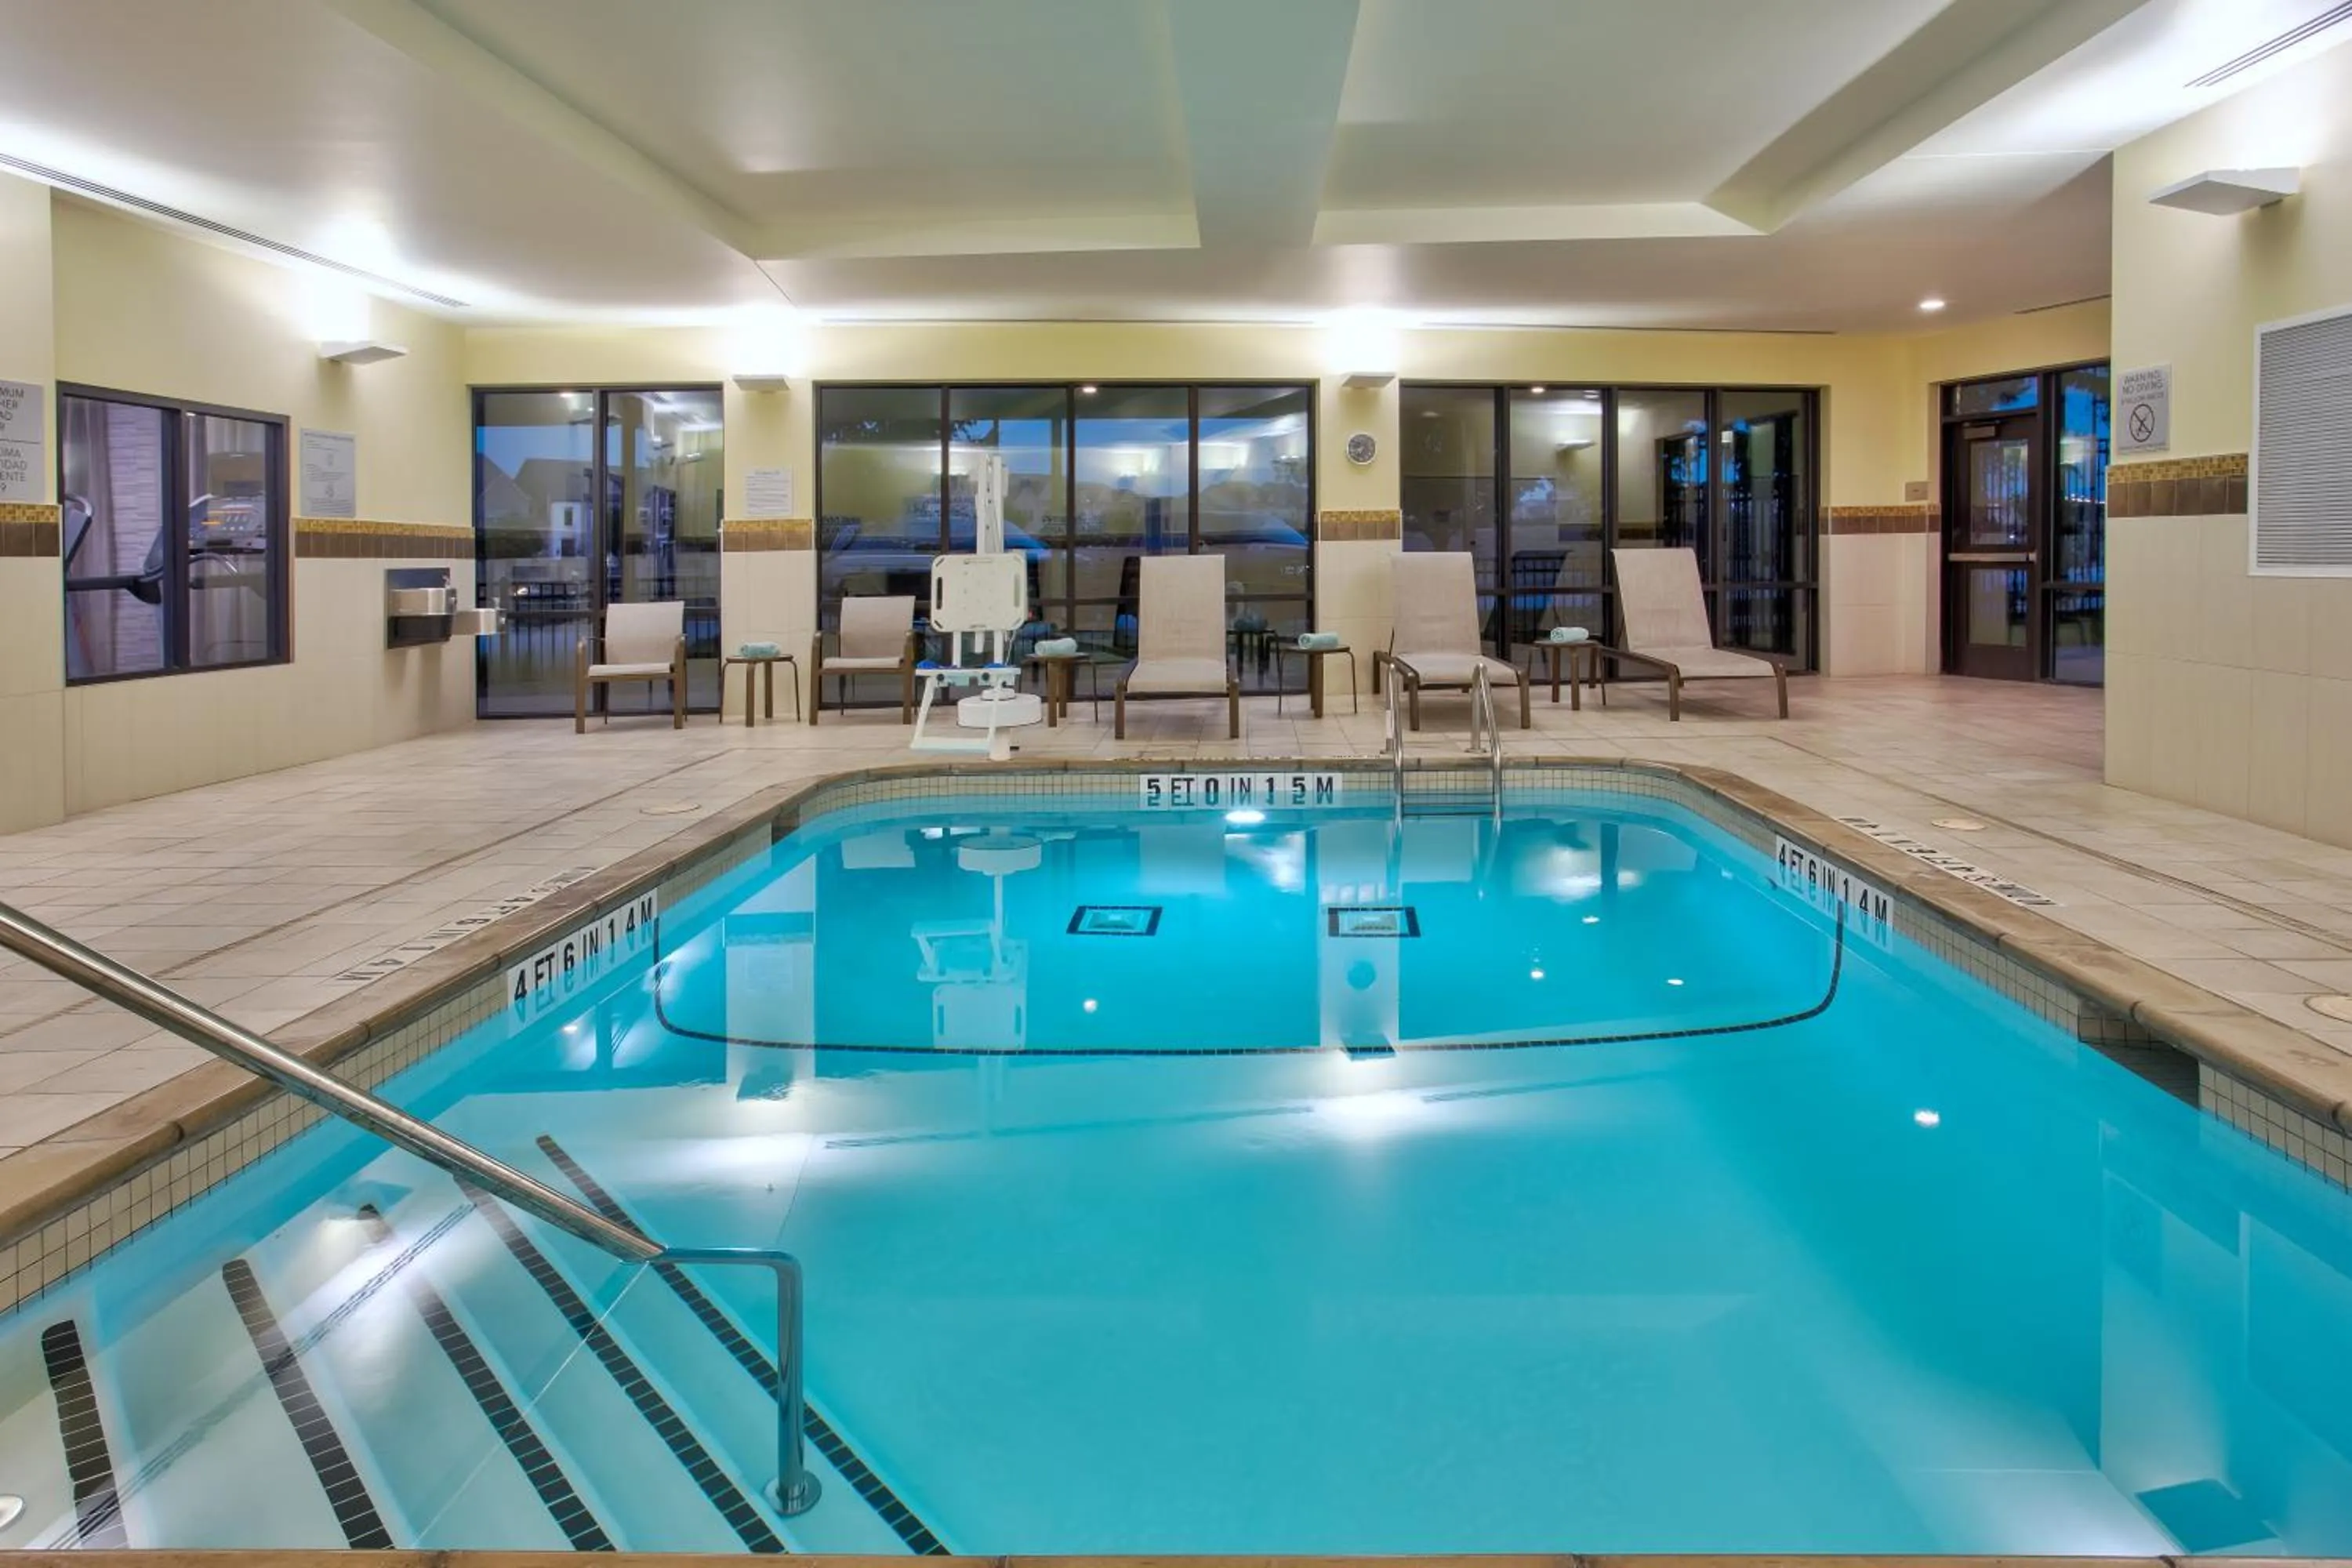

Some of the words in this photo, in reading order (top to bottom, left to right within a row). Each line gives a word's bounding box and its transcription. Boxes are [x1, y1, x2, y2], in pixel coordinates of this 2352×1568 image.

[1230, 777, 1252, 794] IN
[1778, 843, 1787, 866] 4
[1809, 859, 1817, 884] 6
[1823, 866, 1836, 895] IN
[1843, 877, 1849, 902] 1
[1859, 888, 1869, 914] 4
[1875, 895, 1887, 924] M
[514, 969, 527, 1000] 4
[535, 952, 555, 990] FT
[564, 942, 575, 972] 6
[583, 927, 598, 960] IN
[608, 918, 615, 946] 1
[626, 906, 636, 932] 4
[641, 896, 652, 925] M
